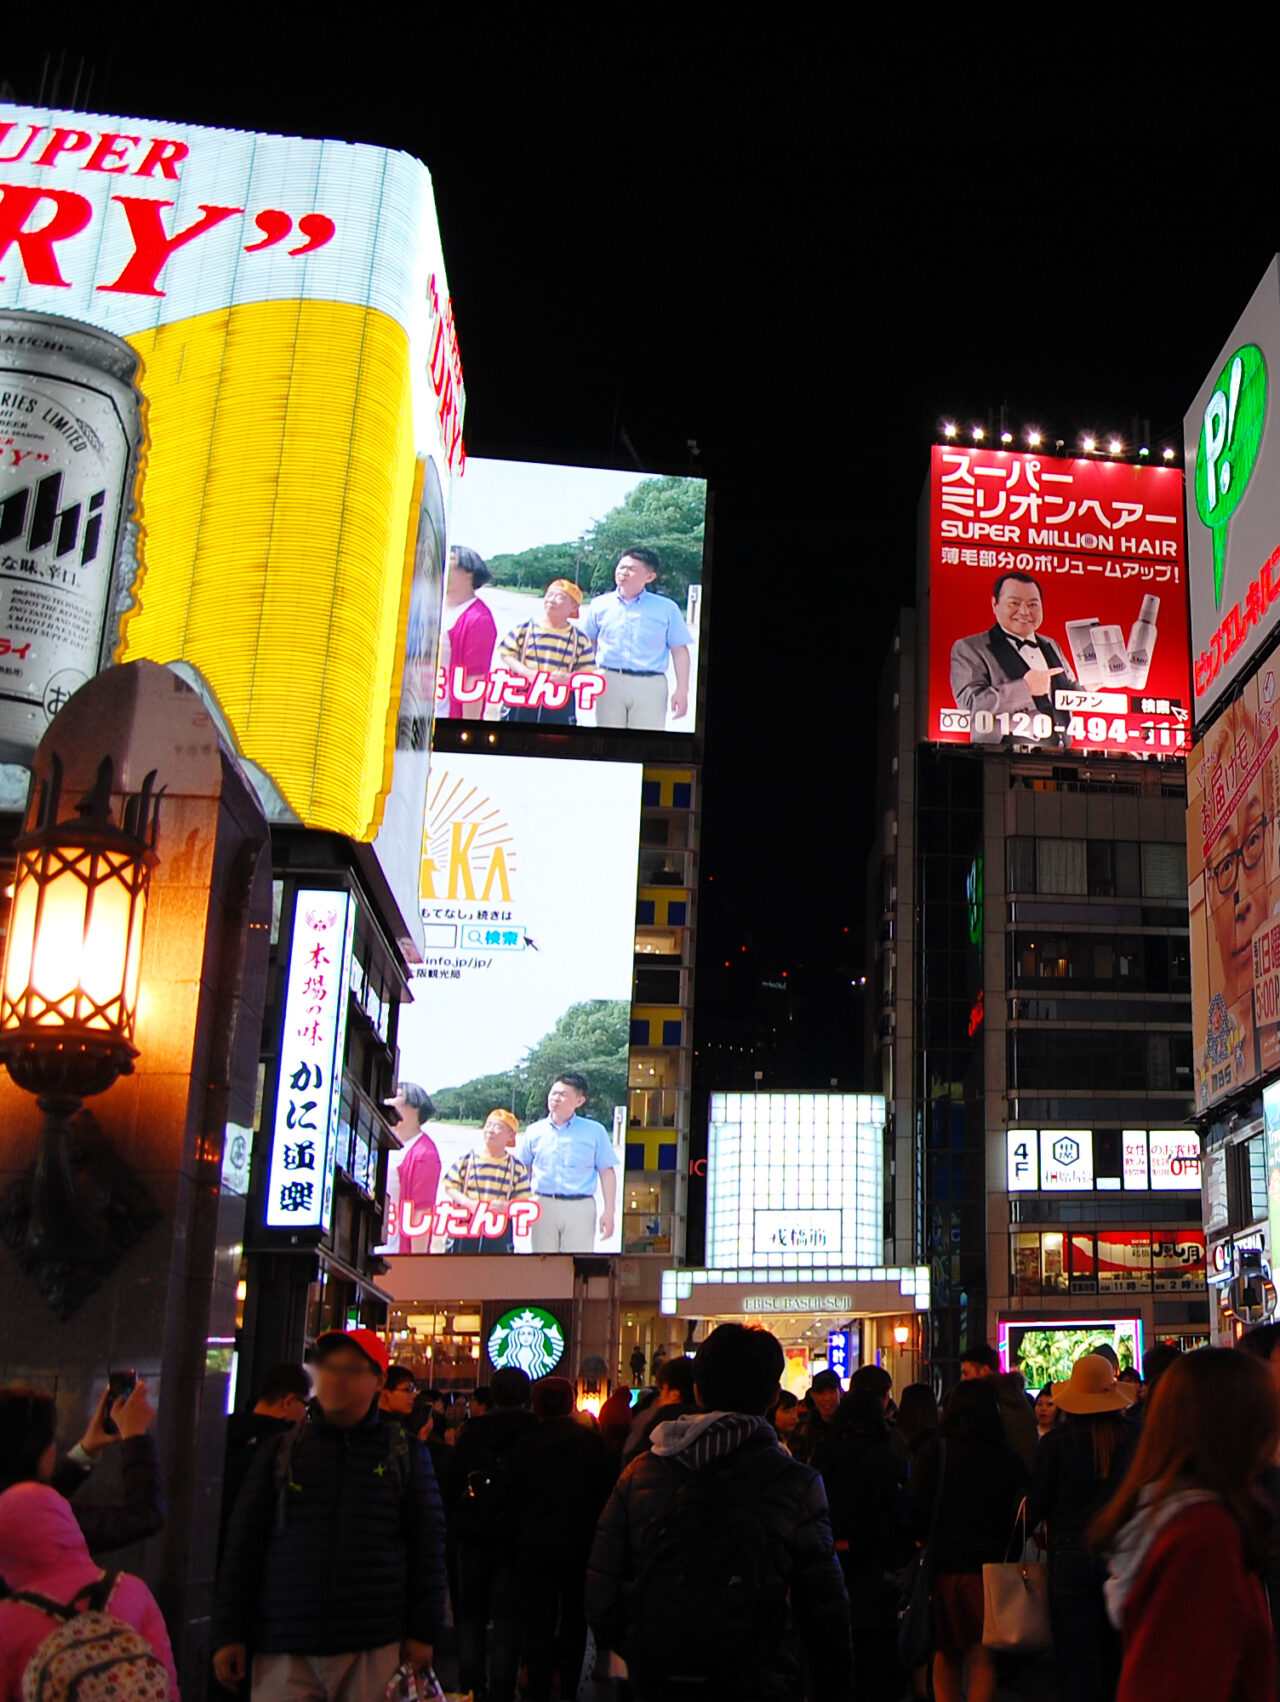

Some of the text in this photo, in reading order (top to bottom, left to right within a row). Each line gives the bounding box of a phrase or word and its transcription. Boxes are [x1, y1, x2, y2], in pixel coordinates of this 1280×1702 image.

[41, 407, 88, 453] LIMITED
[941, 454, 1073, 491] スーパー
[941, 485, 1177, 530] ミリオンヘアー
[941, 520, 1178, 557] SUPER MILLION HAIR
[1060, 694, 1104, 708] ルアン
[1140, 697, 1172, 715] 検索
[485, 930, 519, 945] 検索
[297, 942, 331, 1047] 本場の味
